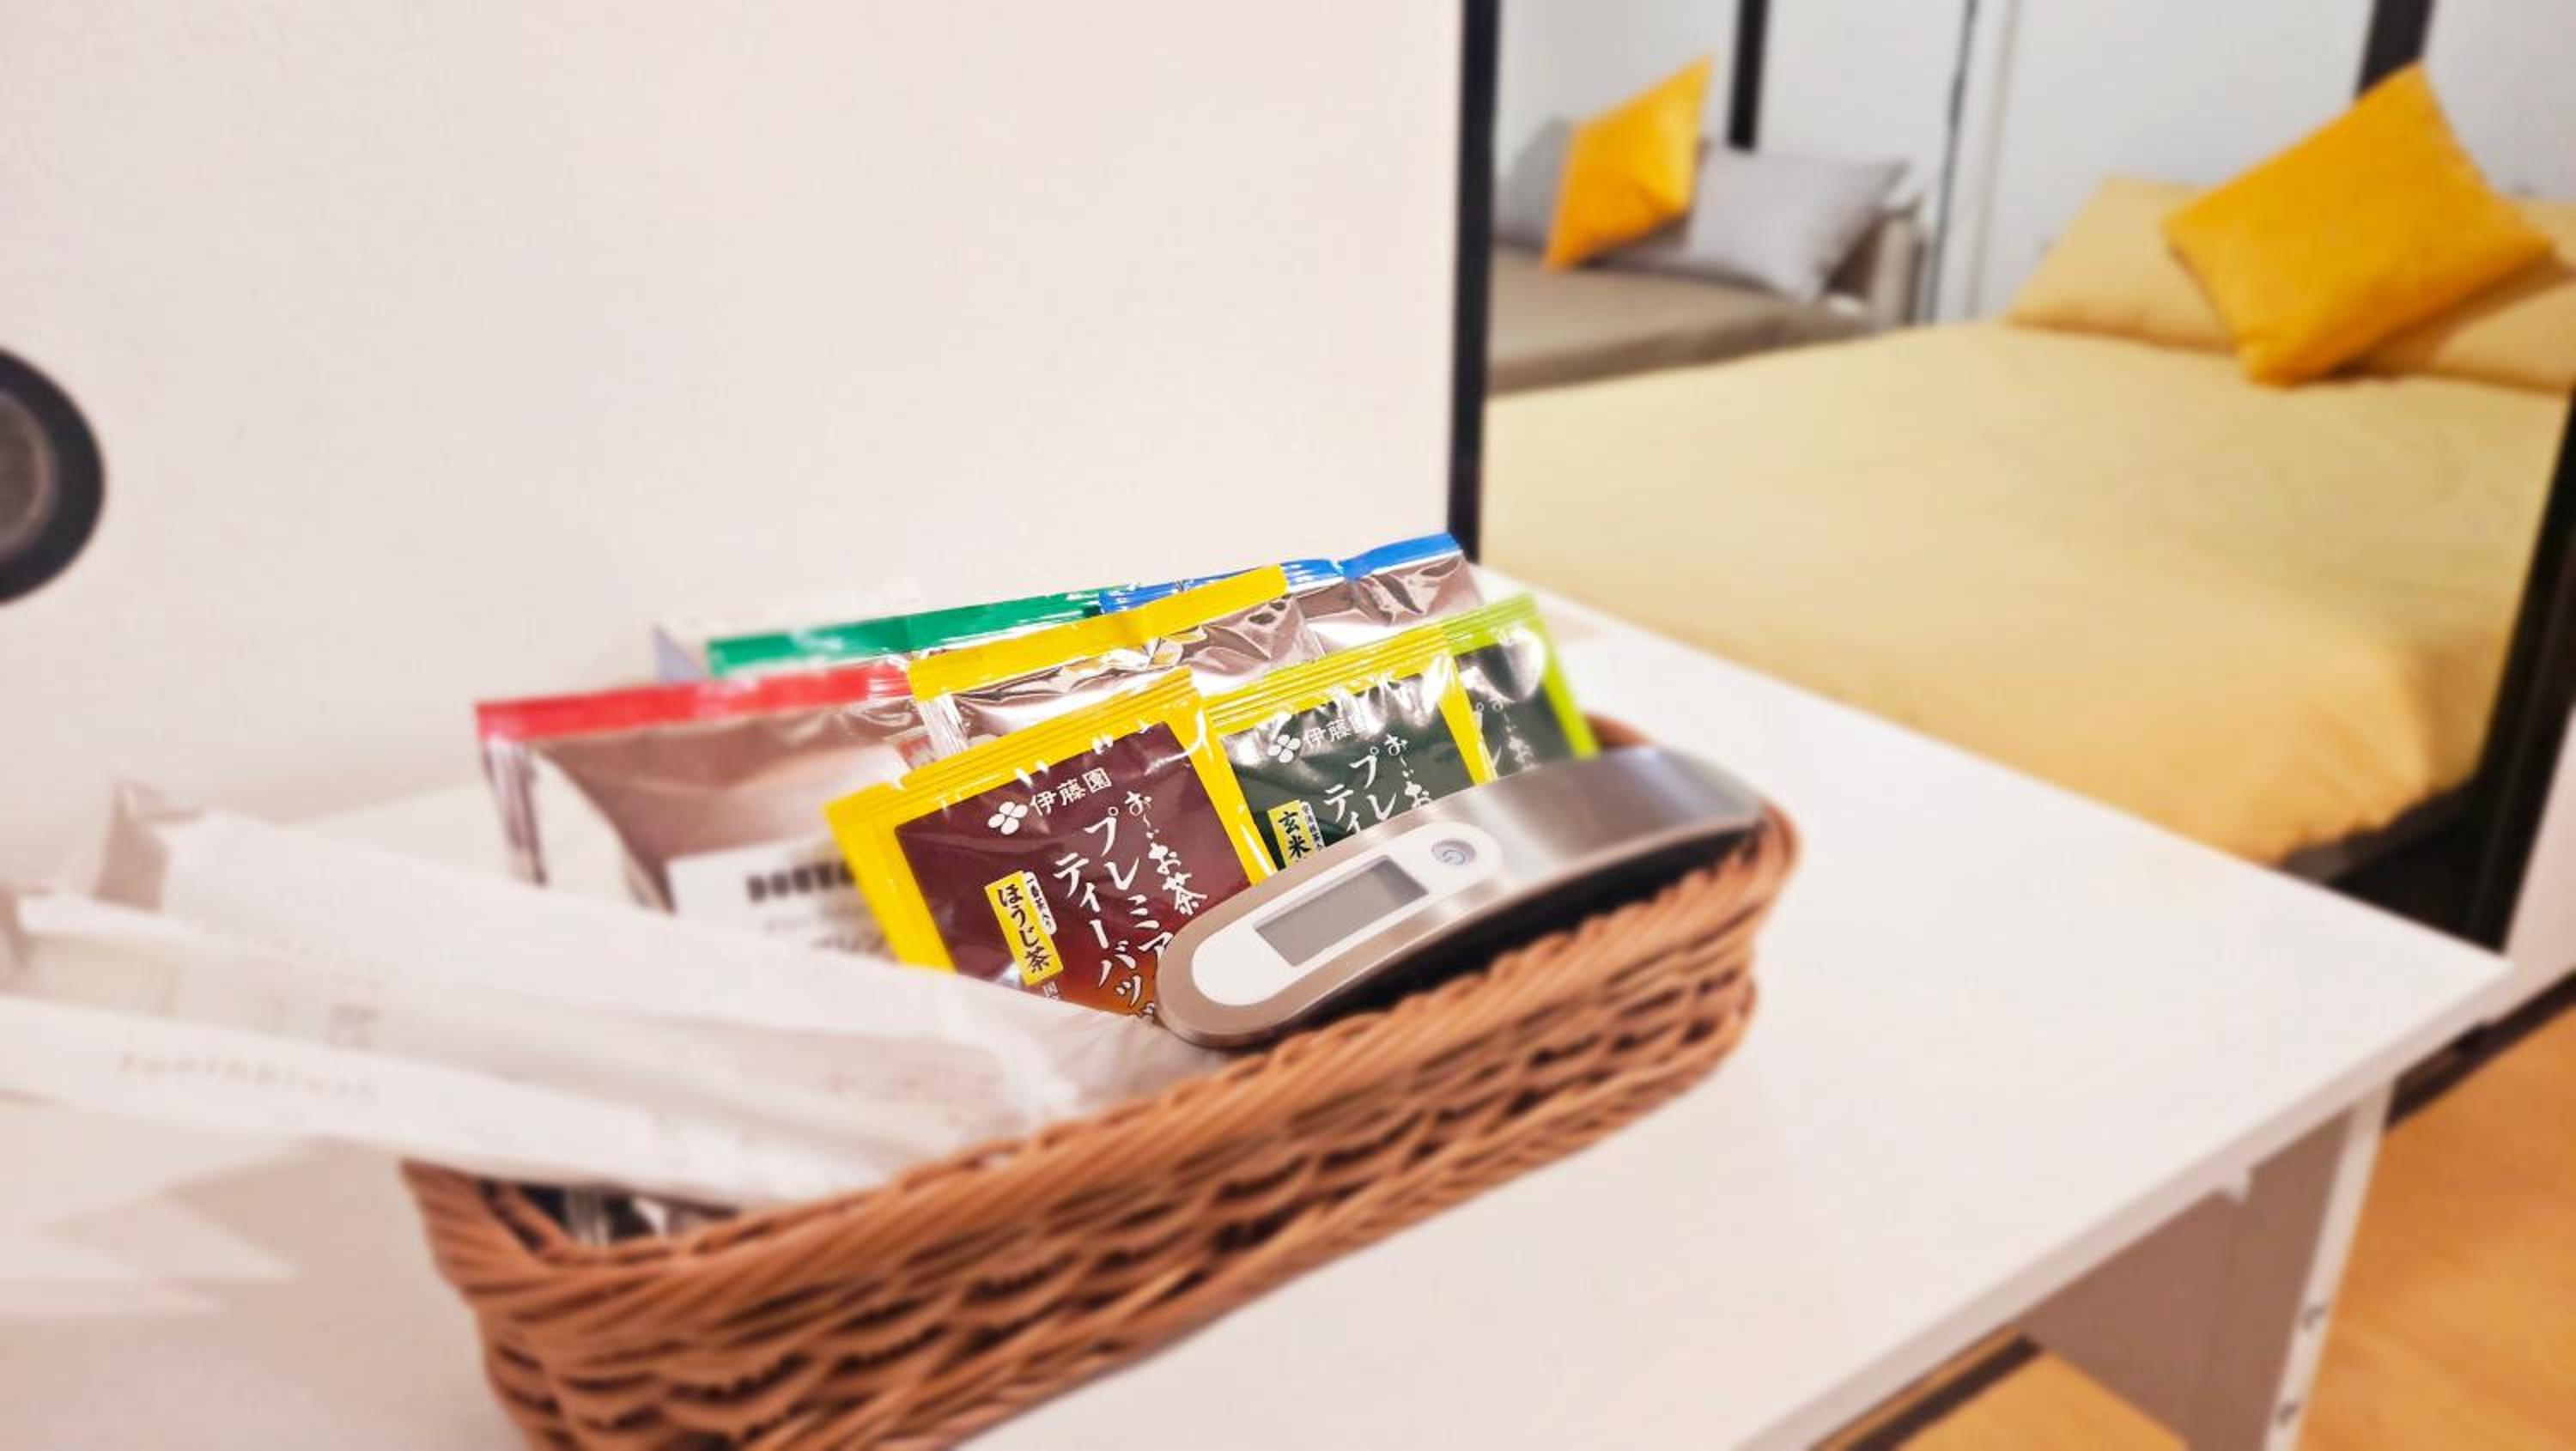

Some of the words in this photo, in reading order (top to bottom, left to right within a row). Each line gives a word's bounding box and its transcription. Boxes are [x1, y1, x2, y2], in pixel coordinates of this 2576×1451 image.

[1030, 767, 1112, 817] 伊藤園
[997, 883, 1052, 974] ほうじ茶
